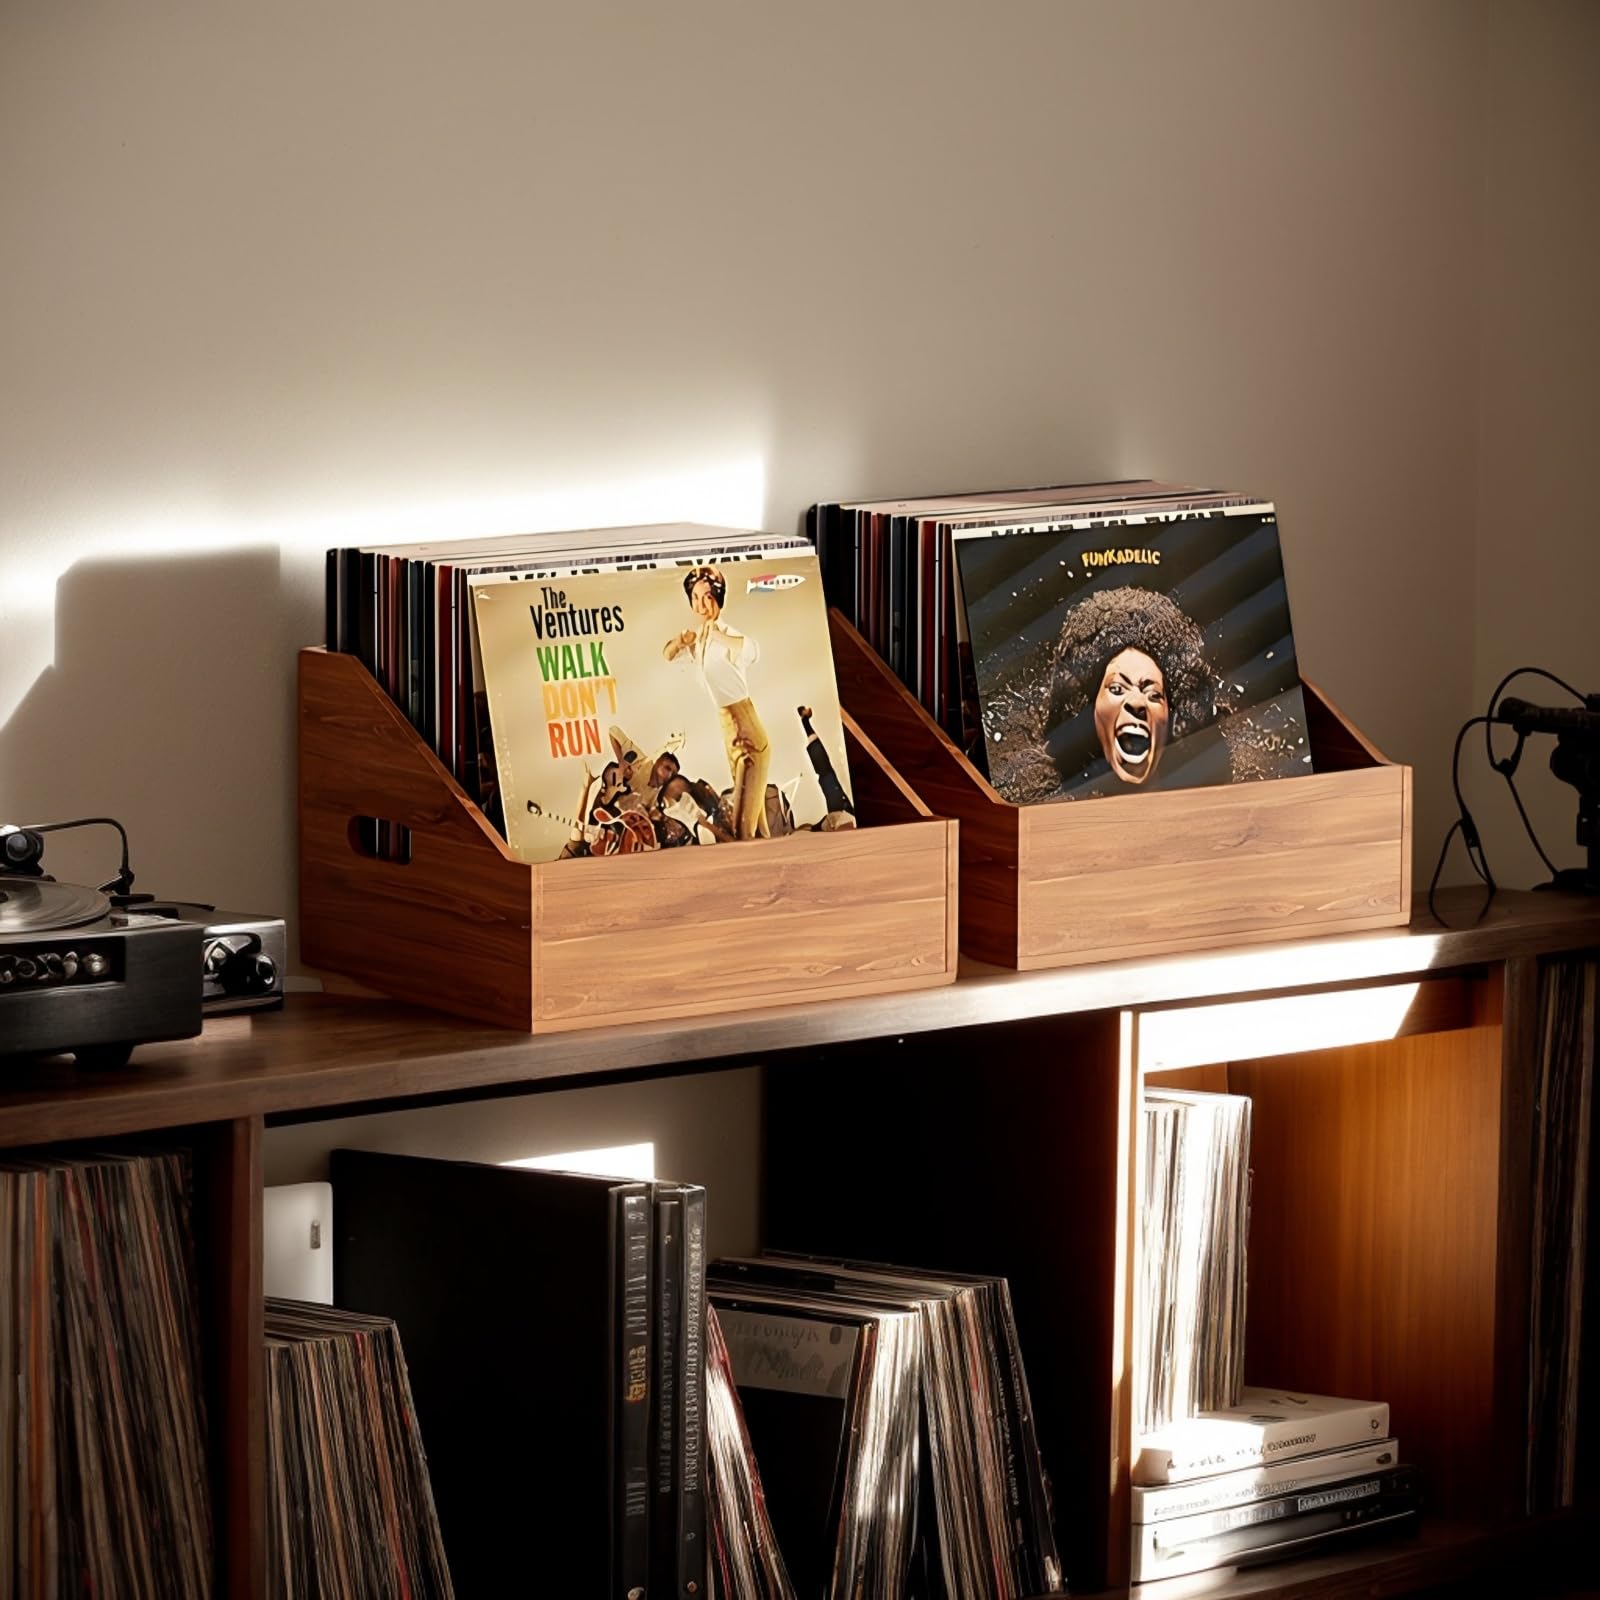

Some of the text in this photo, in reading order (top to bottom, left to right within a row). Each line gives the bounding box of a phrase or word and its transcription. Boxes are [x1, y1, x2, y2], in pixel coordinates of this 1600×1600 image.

[541, 587, 566, 610] The
[529, 604, 625, 640] Ventures
[536, 641, 610, 682] WALK
[542, 678, 617, 720] DON'T
[547, 719, 602, 758] RUN
